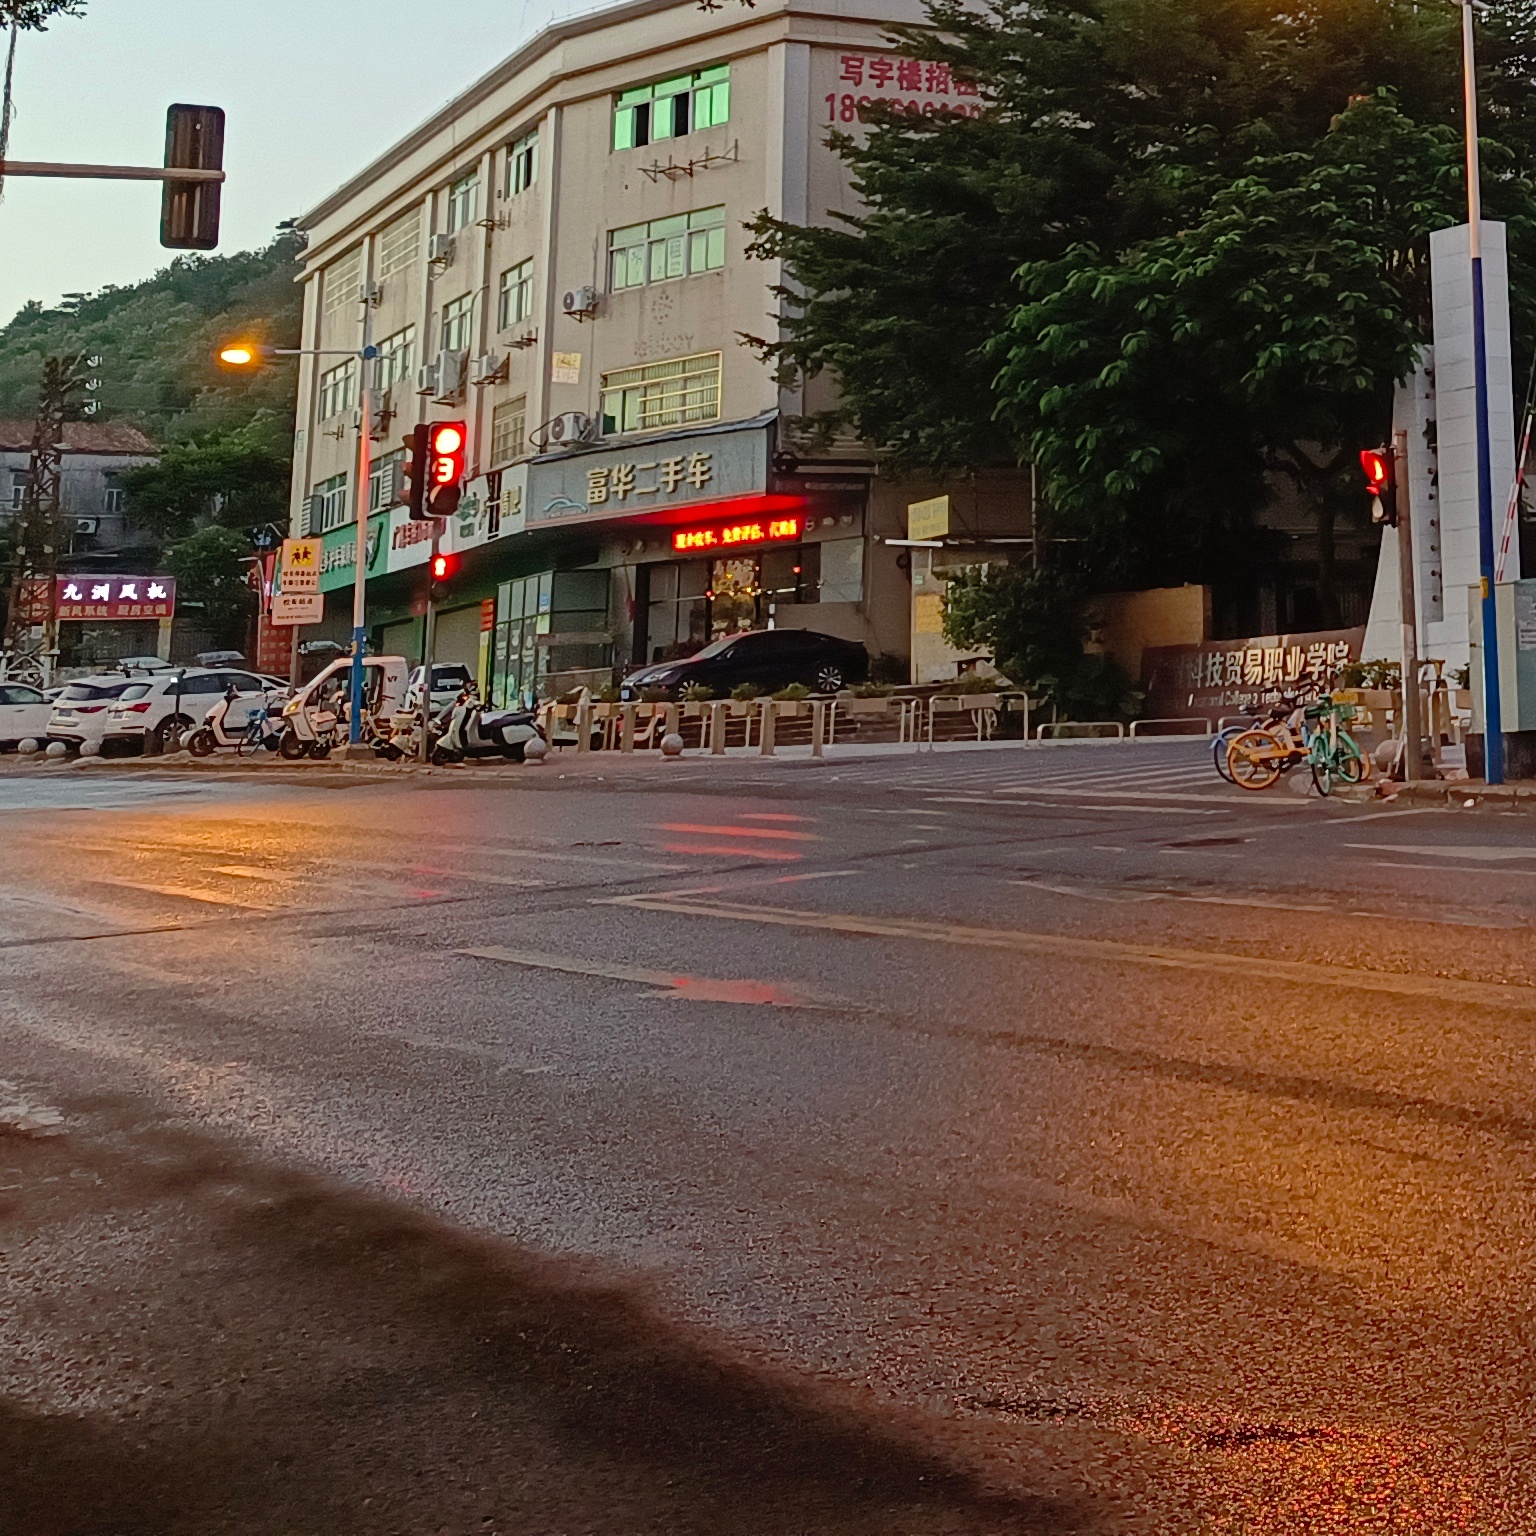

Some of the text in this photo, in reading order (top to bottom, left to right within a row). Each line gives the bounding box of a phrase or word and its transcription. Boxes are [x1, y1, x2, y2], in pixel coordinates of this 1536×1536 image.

[436, 456, 455, 483] 3
[585, 451, 713, 504] 富华二手车
